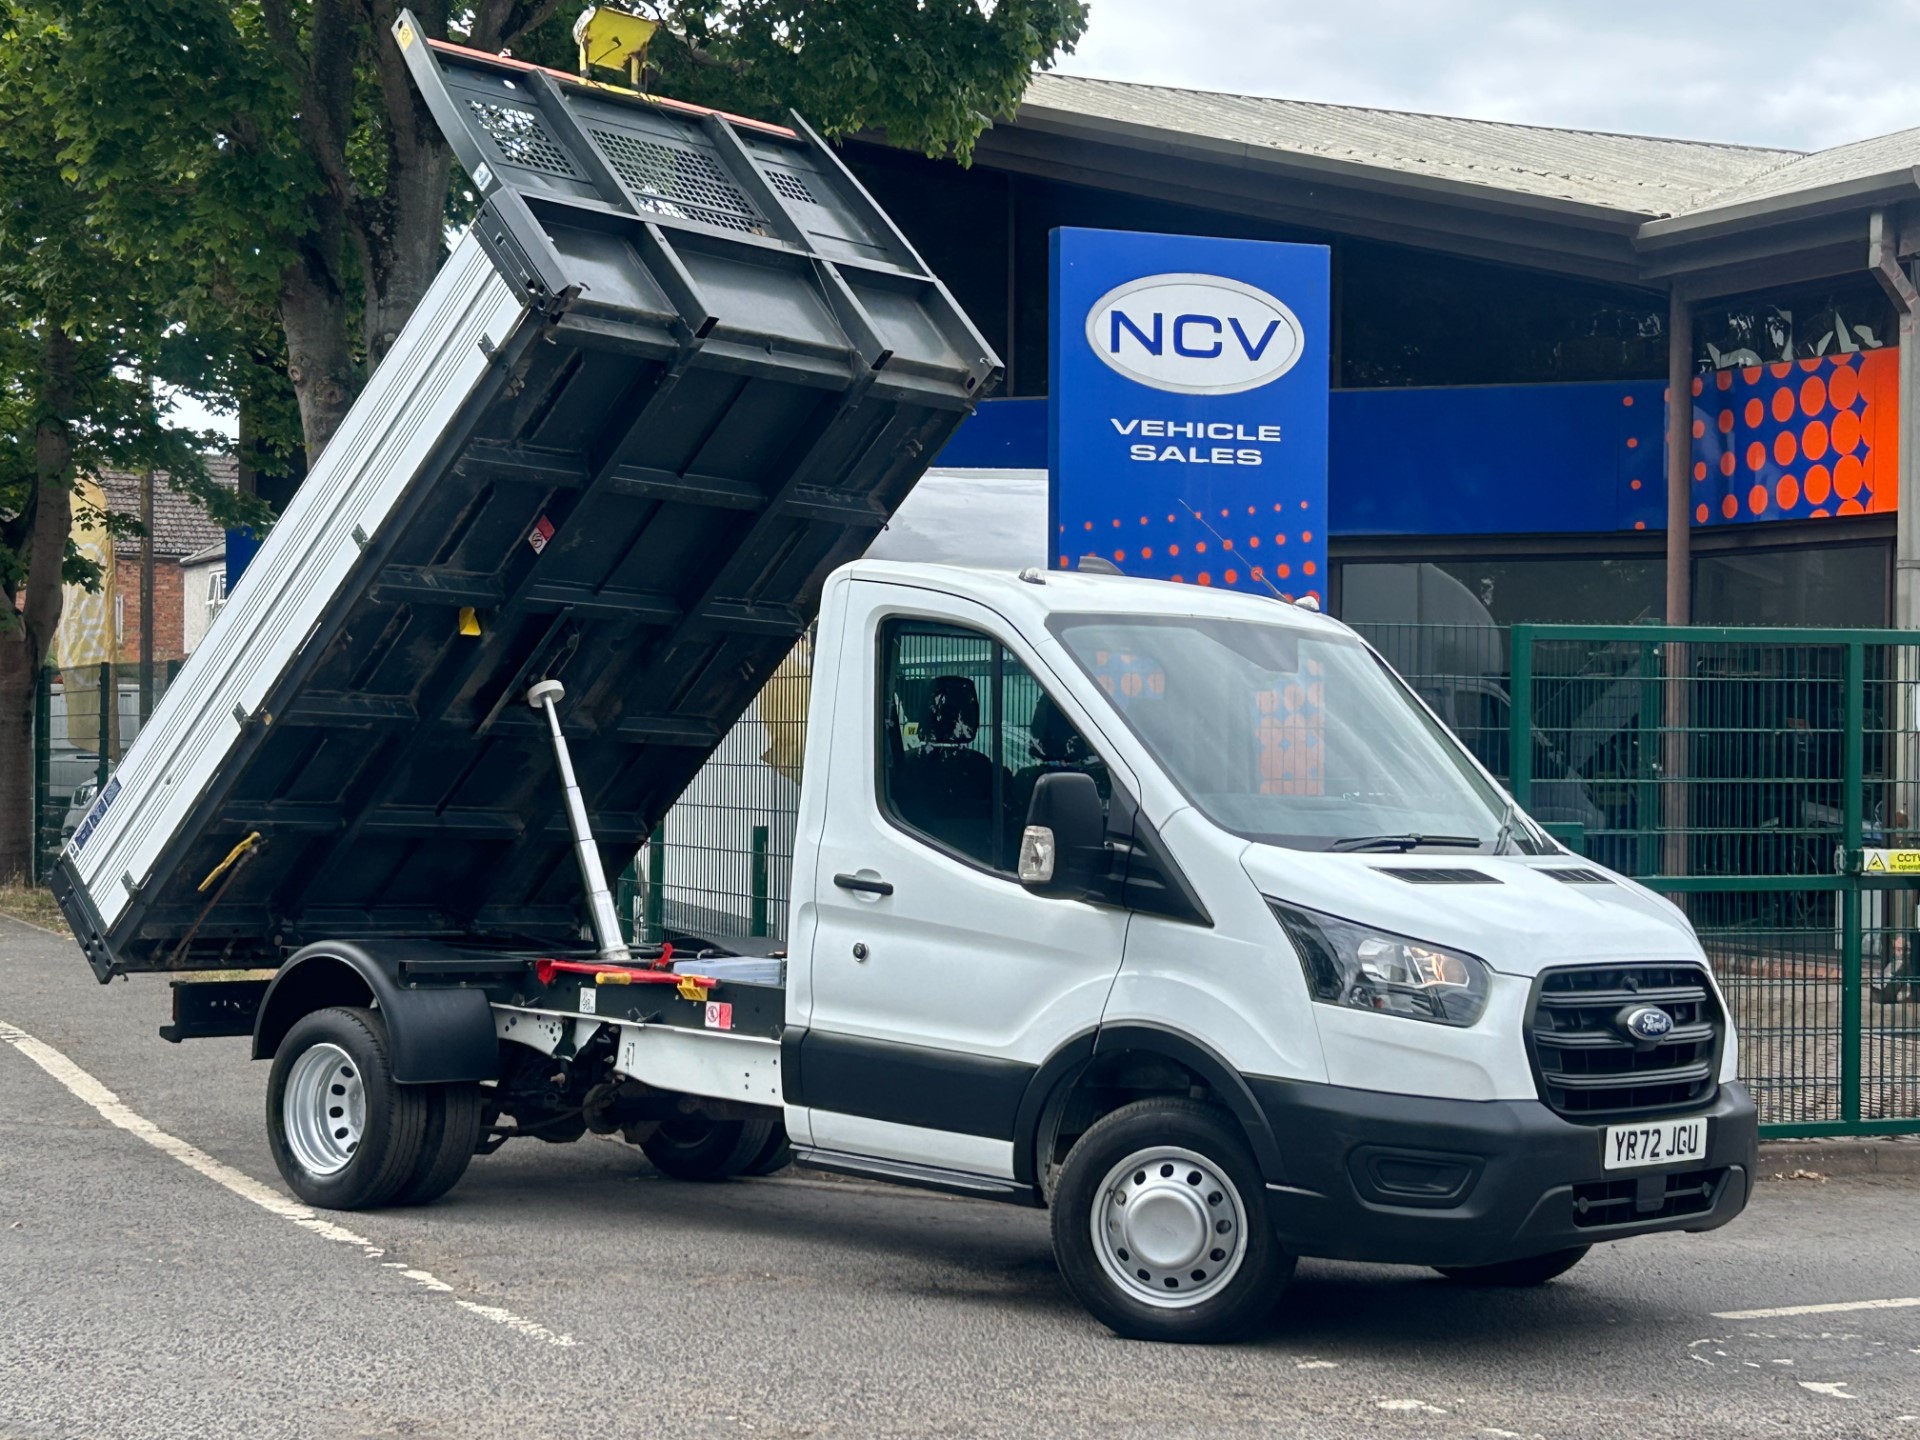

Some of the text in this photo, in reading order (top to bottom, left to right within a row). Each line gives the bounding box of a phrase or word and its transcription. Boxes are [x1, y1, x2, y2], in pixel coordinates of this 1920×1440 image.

[1110, 310, 1281, 361] NCV
[1110, 418, 1281, 442] VEHICLE
[1130, 444, 1262, 466] SALES
[1642, 1013, 1667, 1034] Ford
[1615, 1124, 1699, 1162] YR72 JGU
